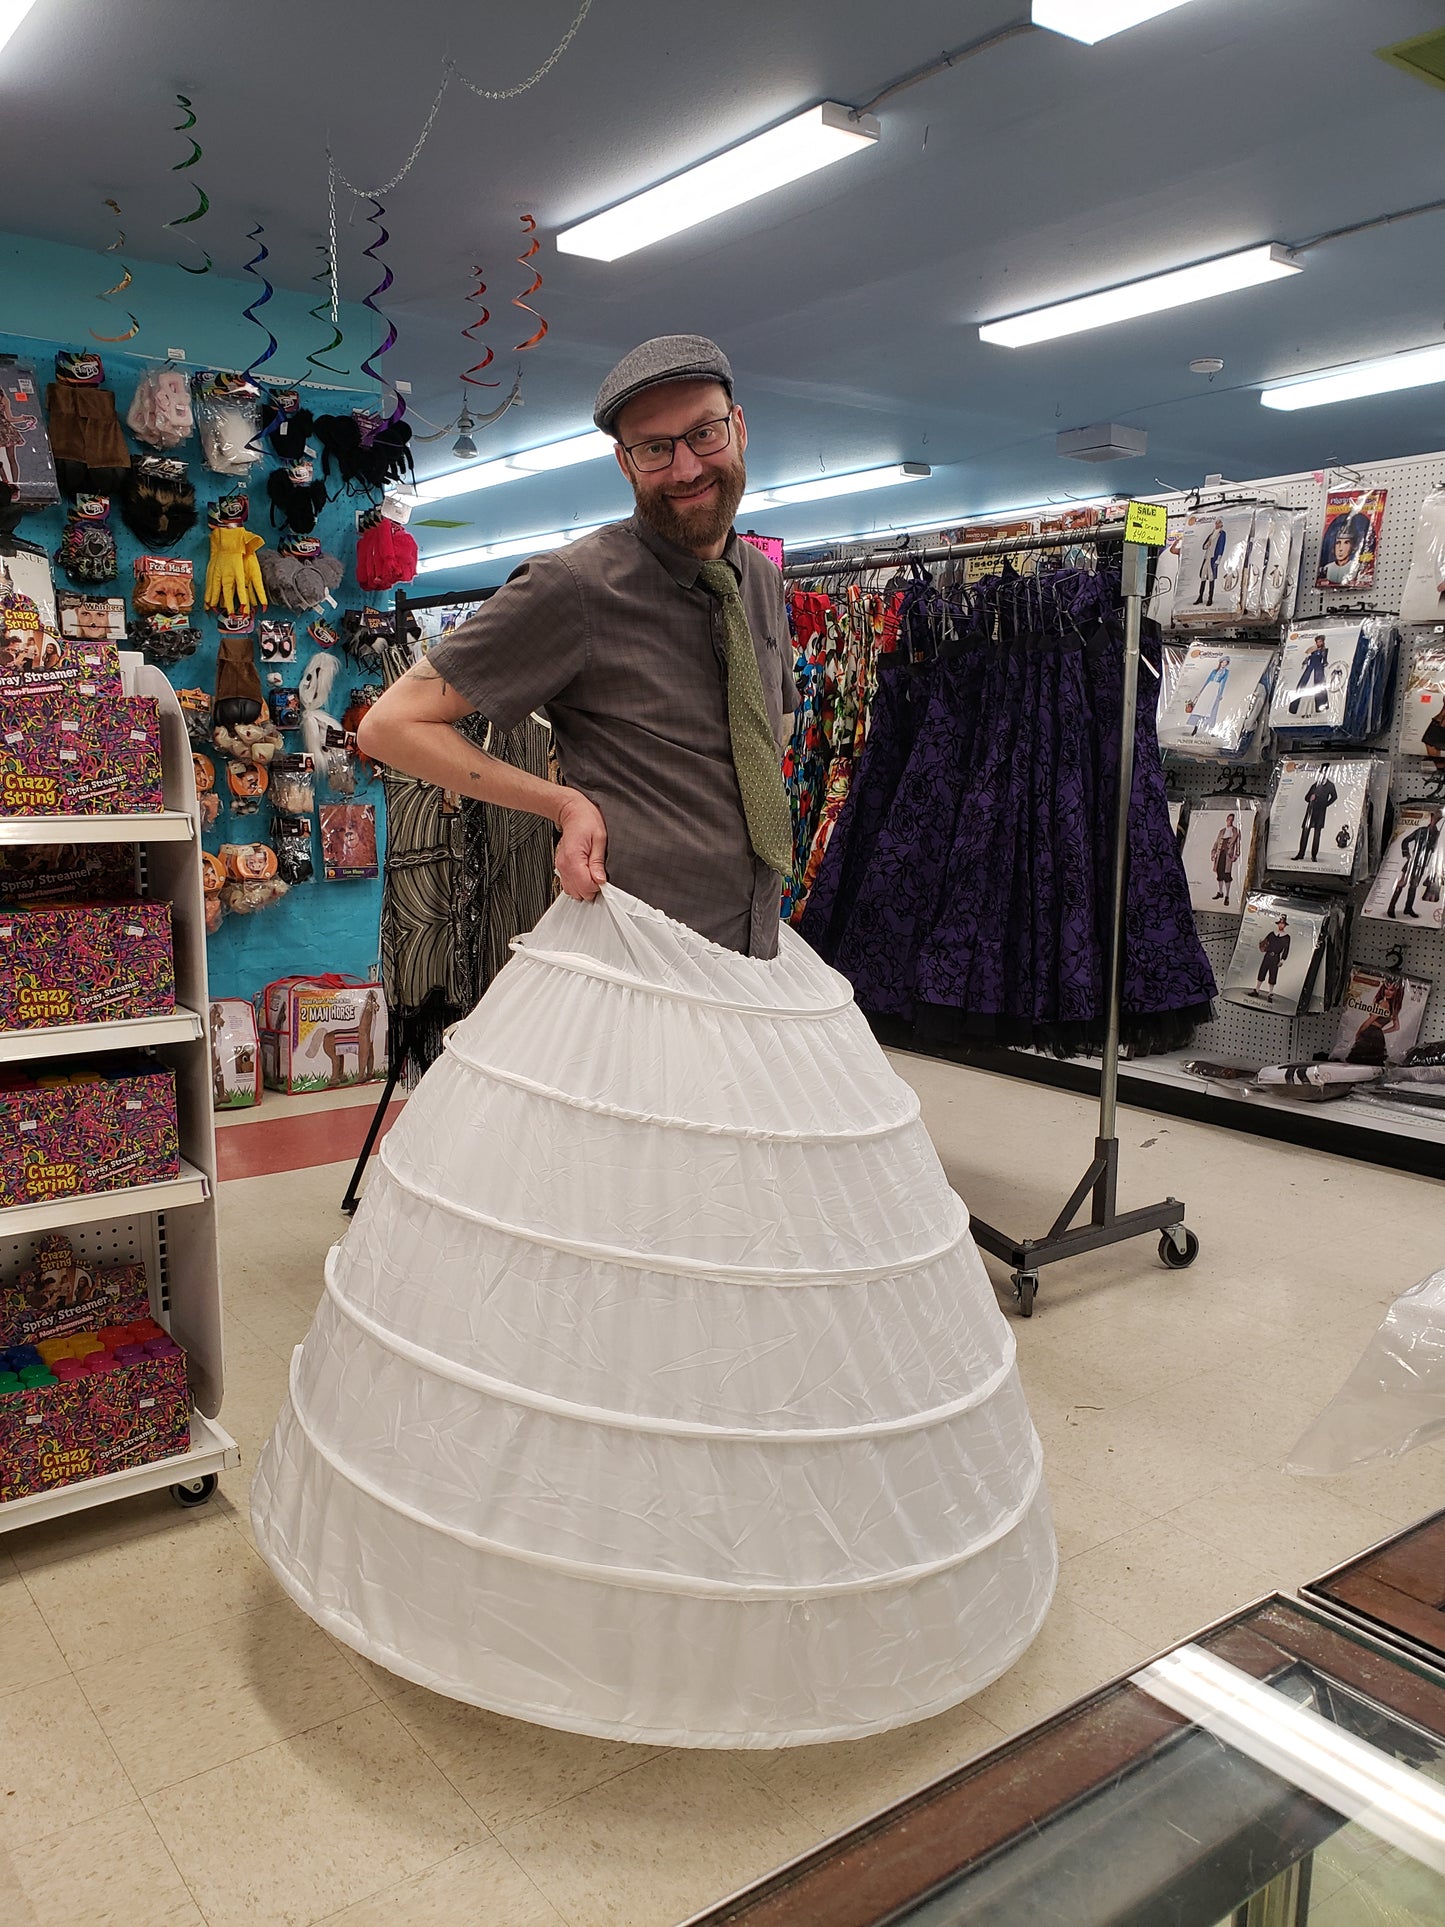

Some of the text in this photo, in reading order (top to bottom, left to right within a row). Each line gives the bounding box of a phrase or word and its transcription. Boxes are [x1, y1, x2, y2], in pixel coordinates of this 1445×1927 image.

[1137, 506, 1157, 517] SALE
[1132, 529, 1146, 540] $40
[149, 562, 193, 574] Fox Mask
[5, 609, 38, 621] Crazy
[86, 602, 124, 612] Whiskers
[4, 619, 39, 630] String
[0, 669, 79, 687] ray Streamer
[4, 684, 63, 696] Non-Flammable
[5, 774, 55, 792] Crazy
[66, 773, 128, 796] Spray Streamer
[3, 790, 55, 806] String
[1, 867, 91, 893] Spray Streamer
[20, 988, 69, 1003] Crazy
[79, 980, 140, 1005] Spray Streamer
[18, 1002, 69, 1019] String
[301, 1005, 356, 1022] 2 MAN HORSE
[1347, 997, 1390, 1017] Crinoline
[28, 1163, 77, 1179] Crazy
[86, 1150, 146, 1178] Spray Streamer
[26, 1175, 77, 1195] String
[41, 1250, 71, 1261] Crazy
[40, 1258, 72, 1272] String
[22, 1296, 109, 1333] Spray Streamer
[39, 1315, 95, 1338] Non-Flammable
[99, 1427, 157, 1459] Spray Streamer
[43, 1448, 90, 1467] Crazy
[41, 1458, 90, 1482] String
